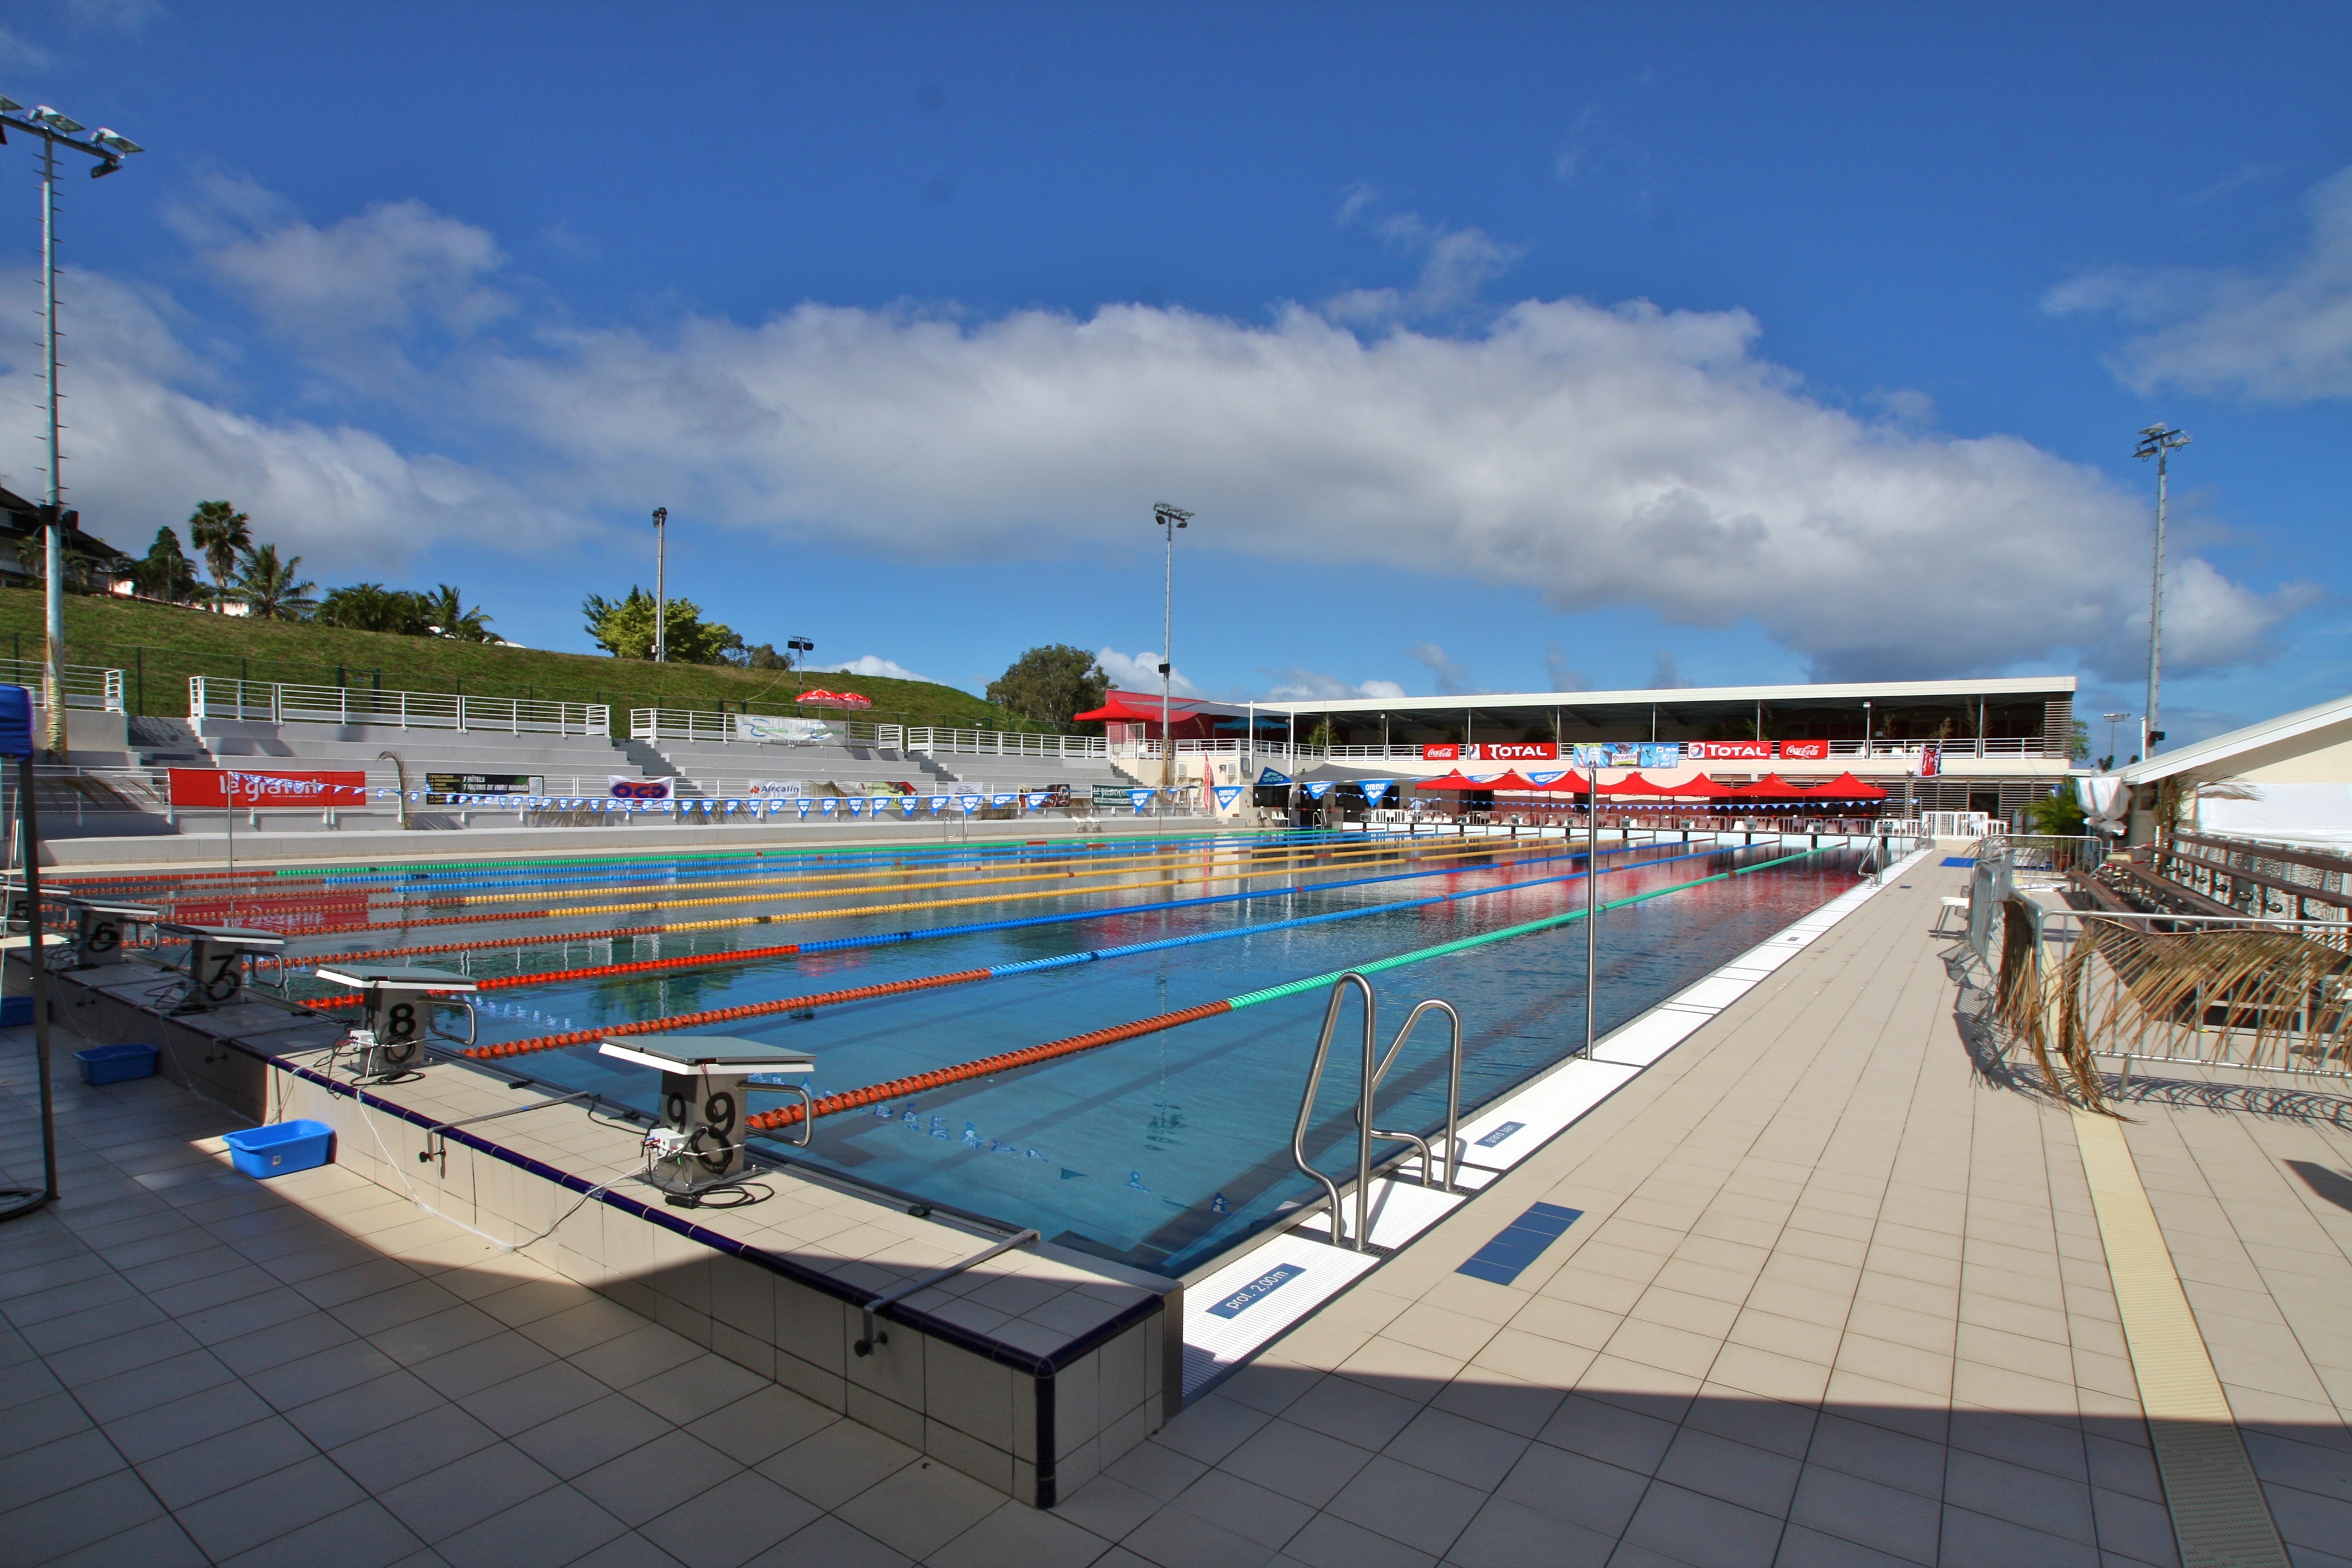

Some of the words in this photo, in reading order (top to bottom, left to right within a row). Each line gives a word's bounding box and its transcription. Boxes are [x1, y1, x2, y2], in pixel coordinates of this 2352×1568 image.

[1488, 744, 1548, 757] TOTAL
[1707, 744, 1767, 756] TOTAL
[219, 775, 240, 794] le
[1534, 771, 1561, 780] arena
[211, 955, 235, 985] 7
[389, 1003, 416, 1037] 8
[667, 1092, 687, 1135] 9
[705, 1092, 736, 1139] 9
[1226, 1292, 1256, 1310] prof.
[1250, 1271, 1289, 1292] 2,00m
